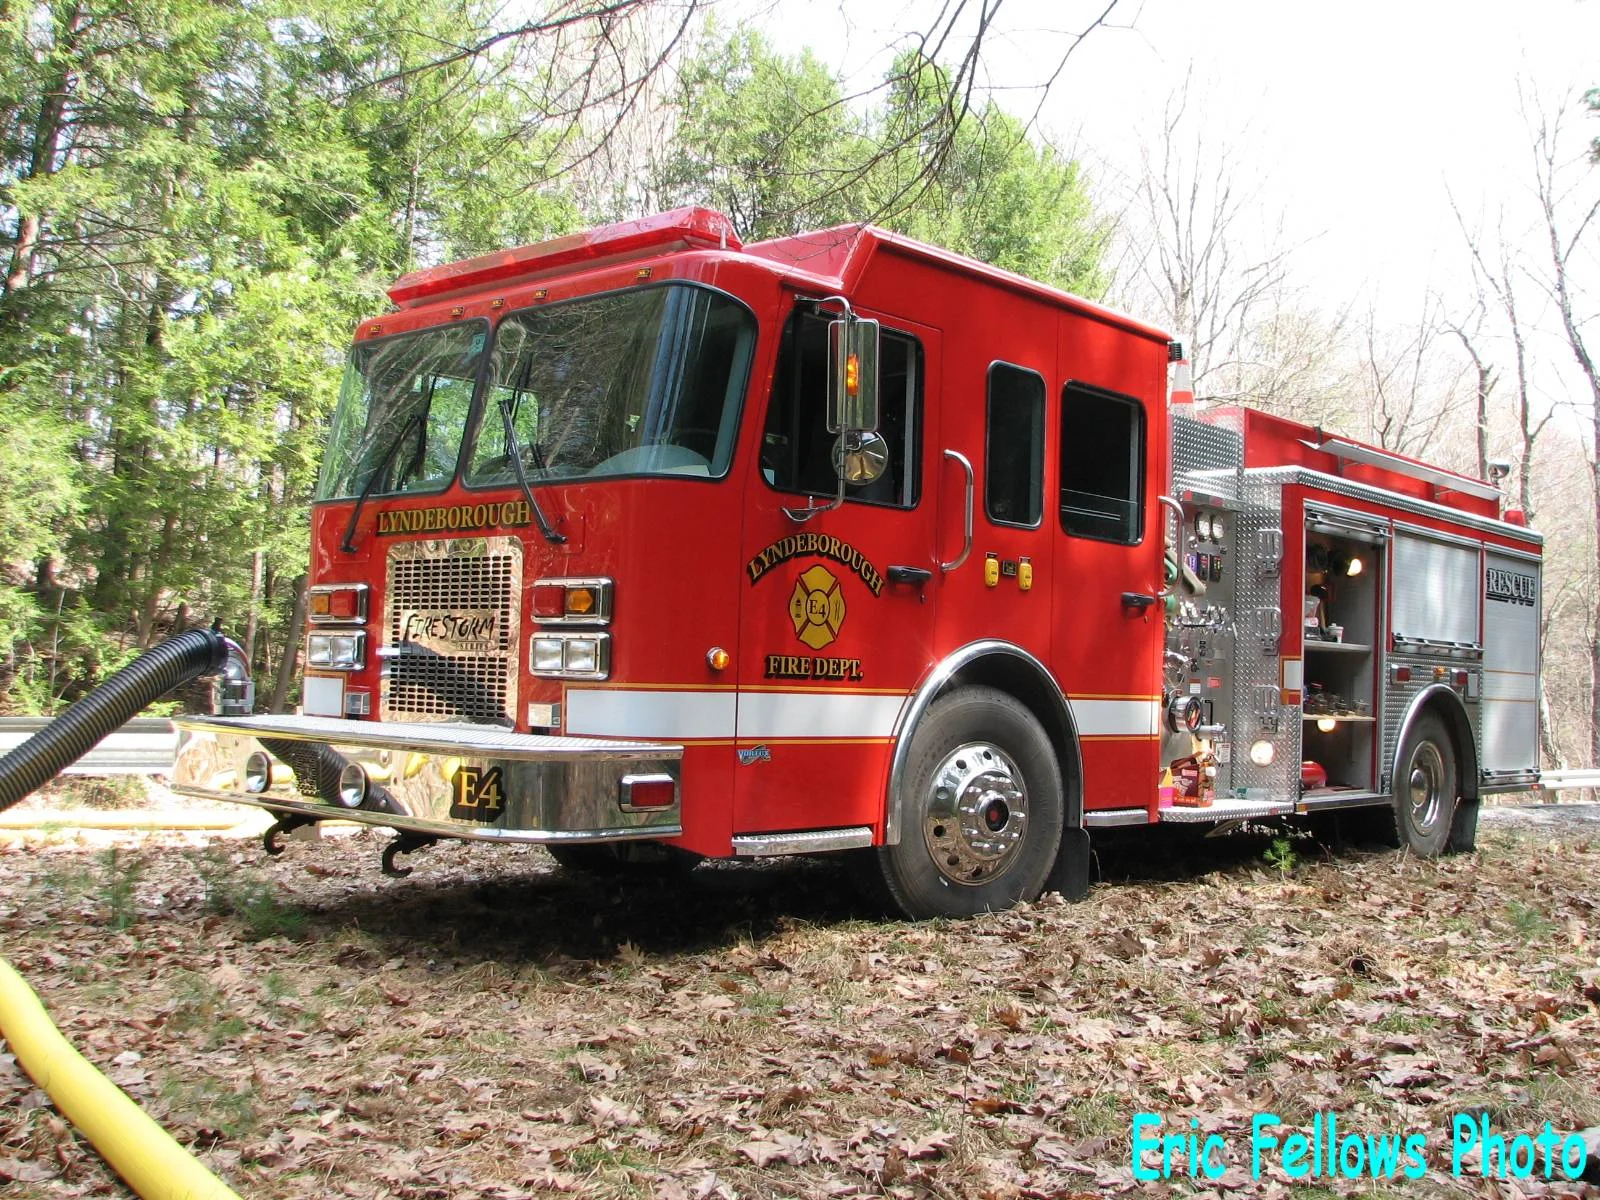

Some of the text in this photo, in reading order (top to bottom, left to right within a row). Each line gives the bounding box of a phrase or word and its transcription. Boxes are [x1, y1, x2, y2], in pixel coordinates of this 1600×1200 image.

[378, 501, 532, 535] LYNDEBOROUGH
[747, 533, 884, 596] LYNDEBOROUGH
[1487, 568, 1536, 605] RESCUE
[808, 599, 826, 618] E4
[403, 613, 495, 645] FIRESTORM
[766, 655, 864, 681] FIRE DEPT.
[457, 771, 502, 810] E4
